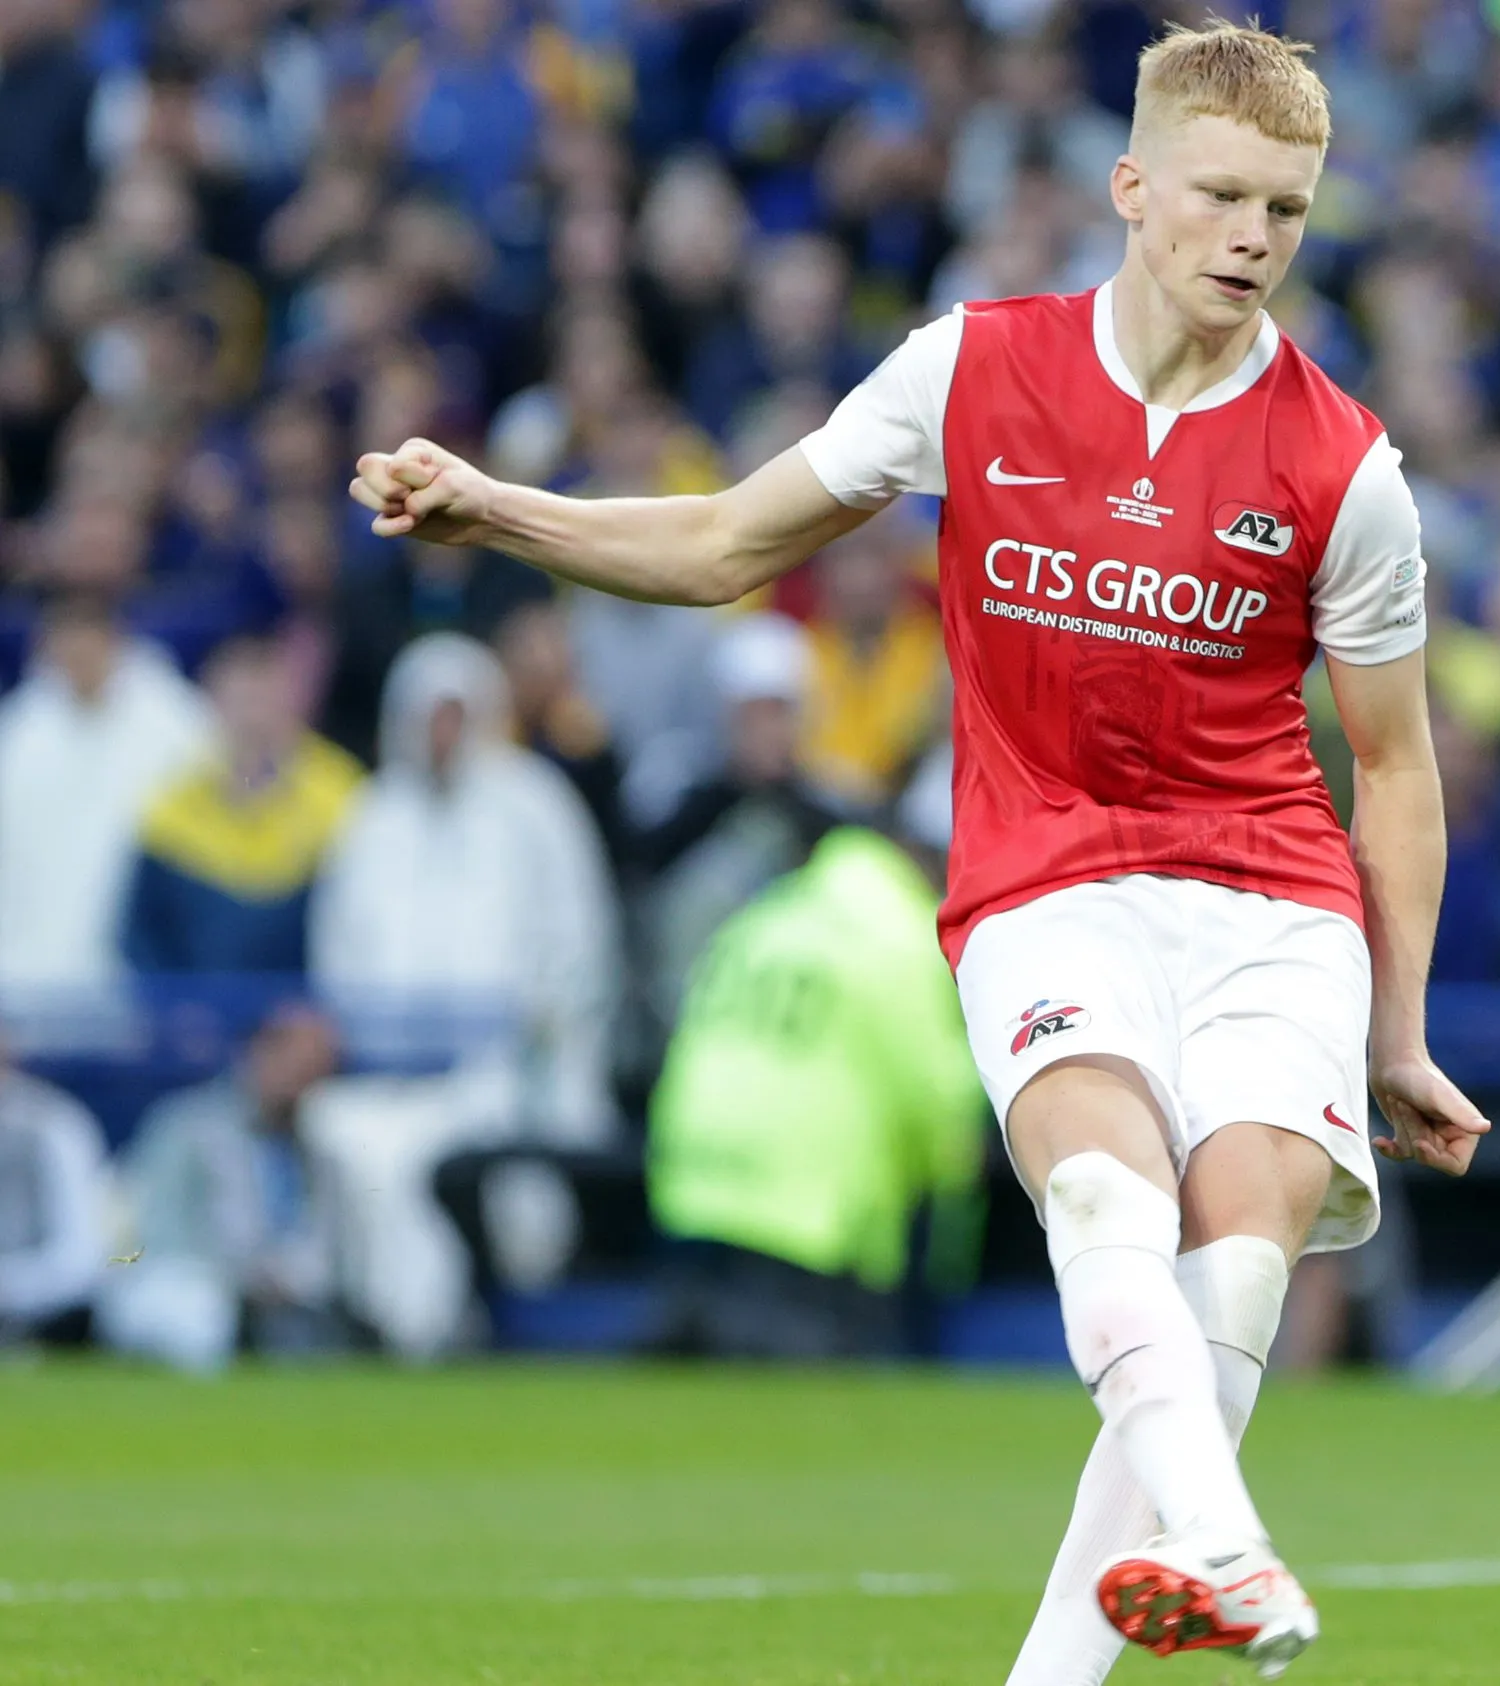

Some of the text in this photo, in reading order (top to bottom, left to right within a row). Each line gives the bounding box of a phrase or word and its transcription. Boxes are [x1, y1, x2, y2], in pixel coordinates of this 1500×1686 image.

[1227, 511, 1280, 548] AZ
[984, 538, 1267, 634] CTS GROUP
[982, 597, 1245, 659] EUROPEAN DISTRIBUTION & LOGISTICS
[1027, 1015, 1076, 1047] AZ
